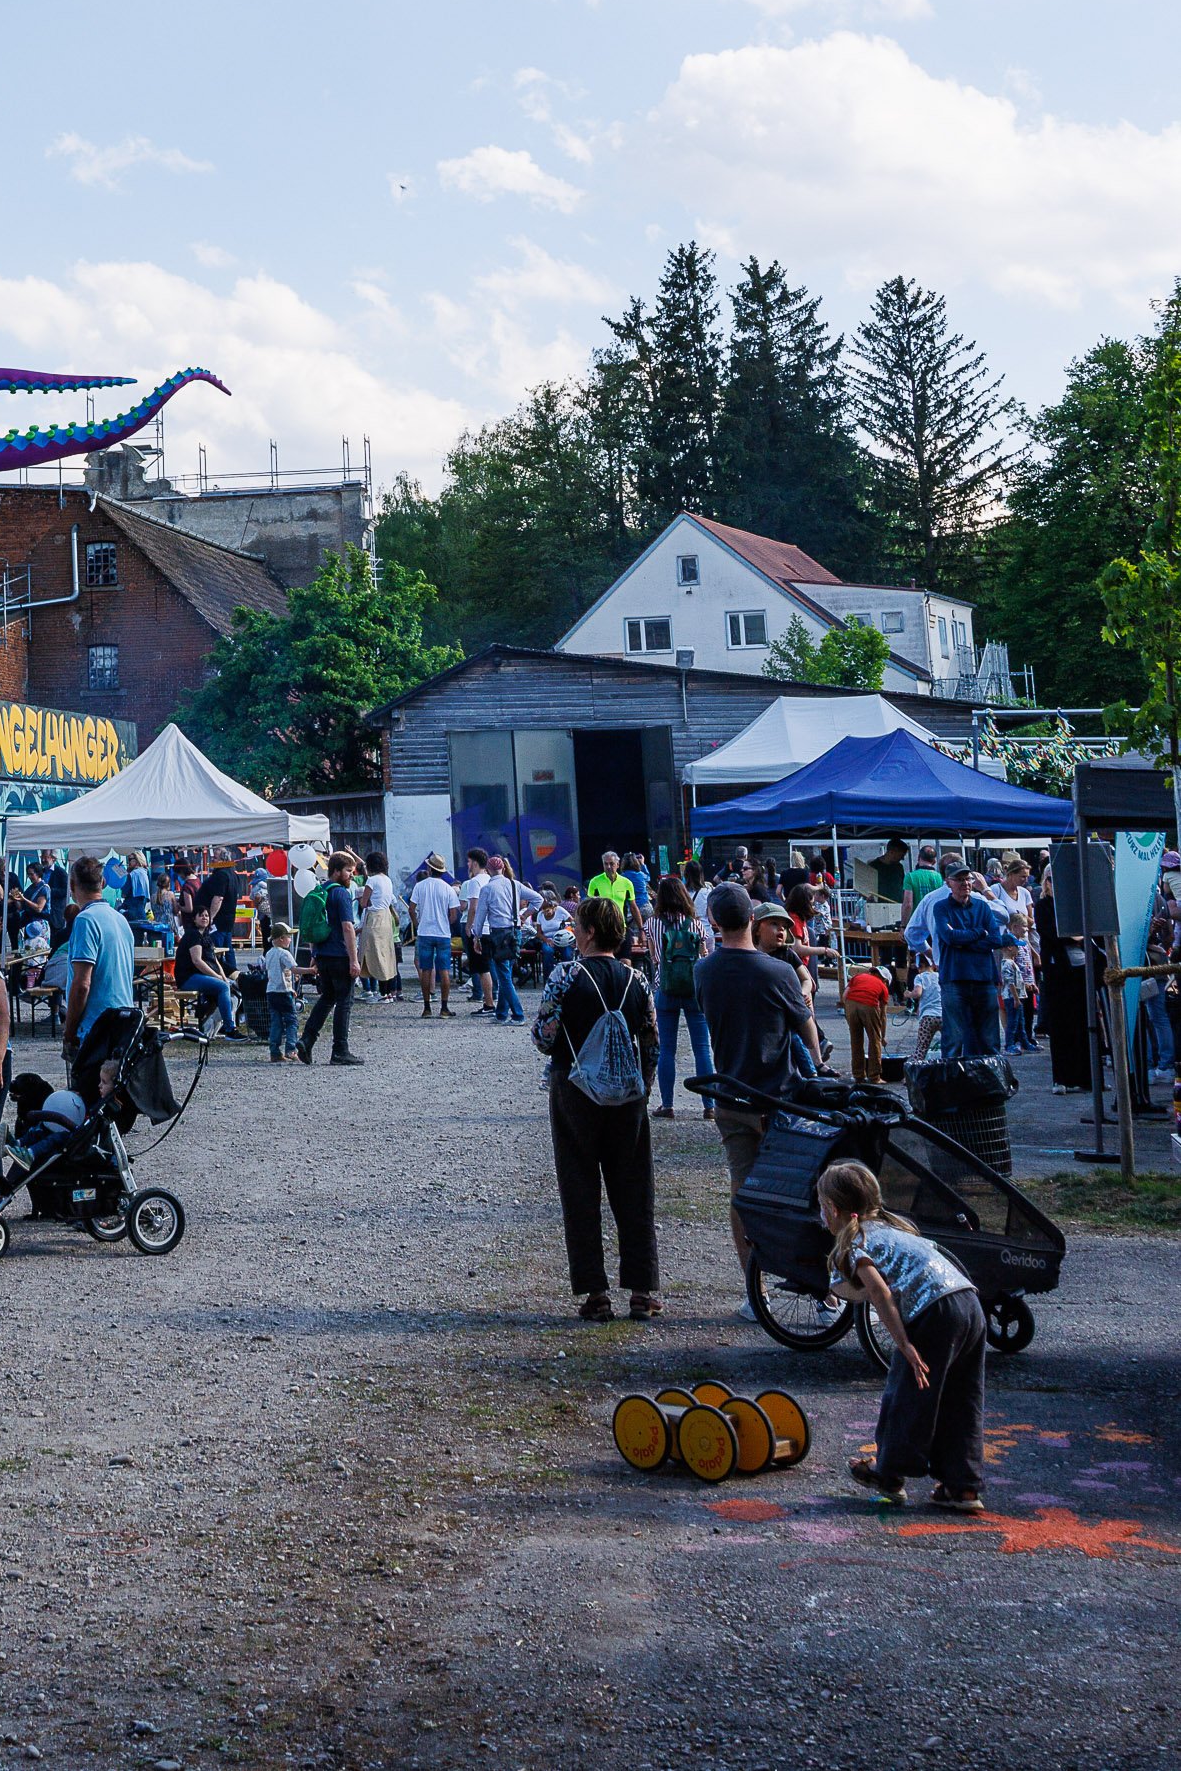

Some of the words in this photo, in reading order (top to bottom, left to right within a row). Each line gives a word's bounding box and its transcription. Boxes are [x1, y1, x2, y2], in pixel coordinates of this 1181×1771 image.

[1138, 850, 1150, 861] MAL
[1000, 1248, 1047, 1269] Qeridoo
[633, 1426, 659, 1460] pedalo
[698, 1437, 726, 1472] pedalo
